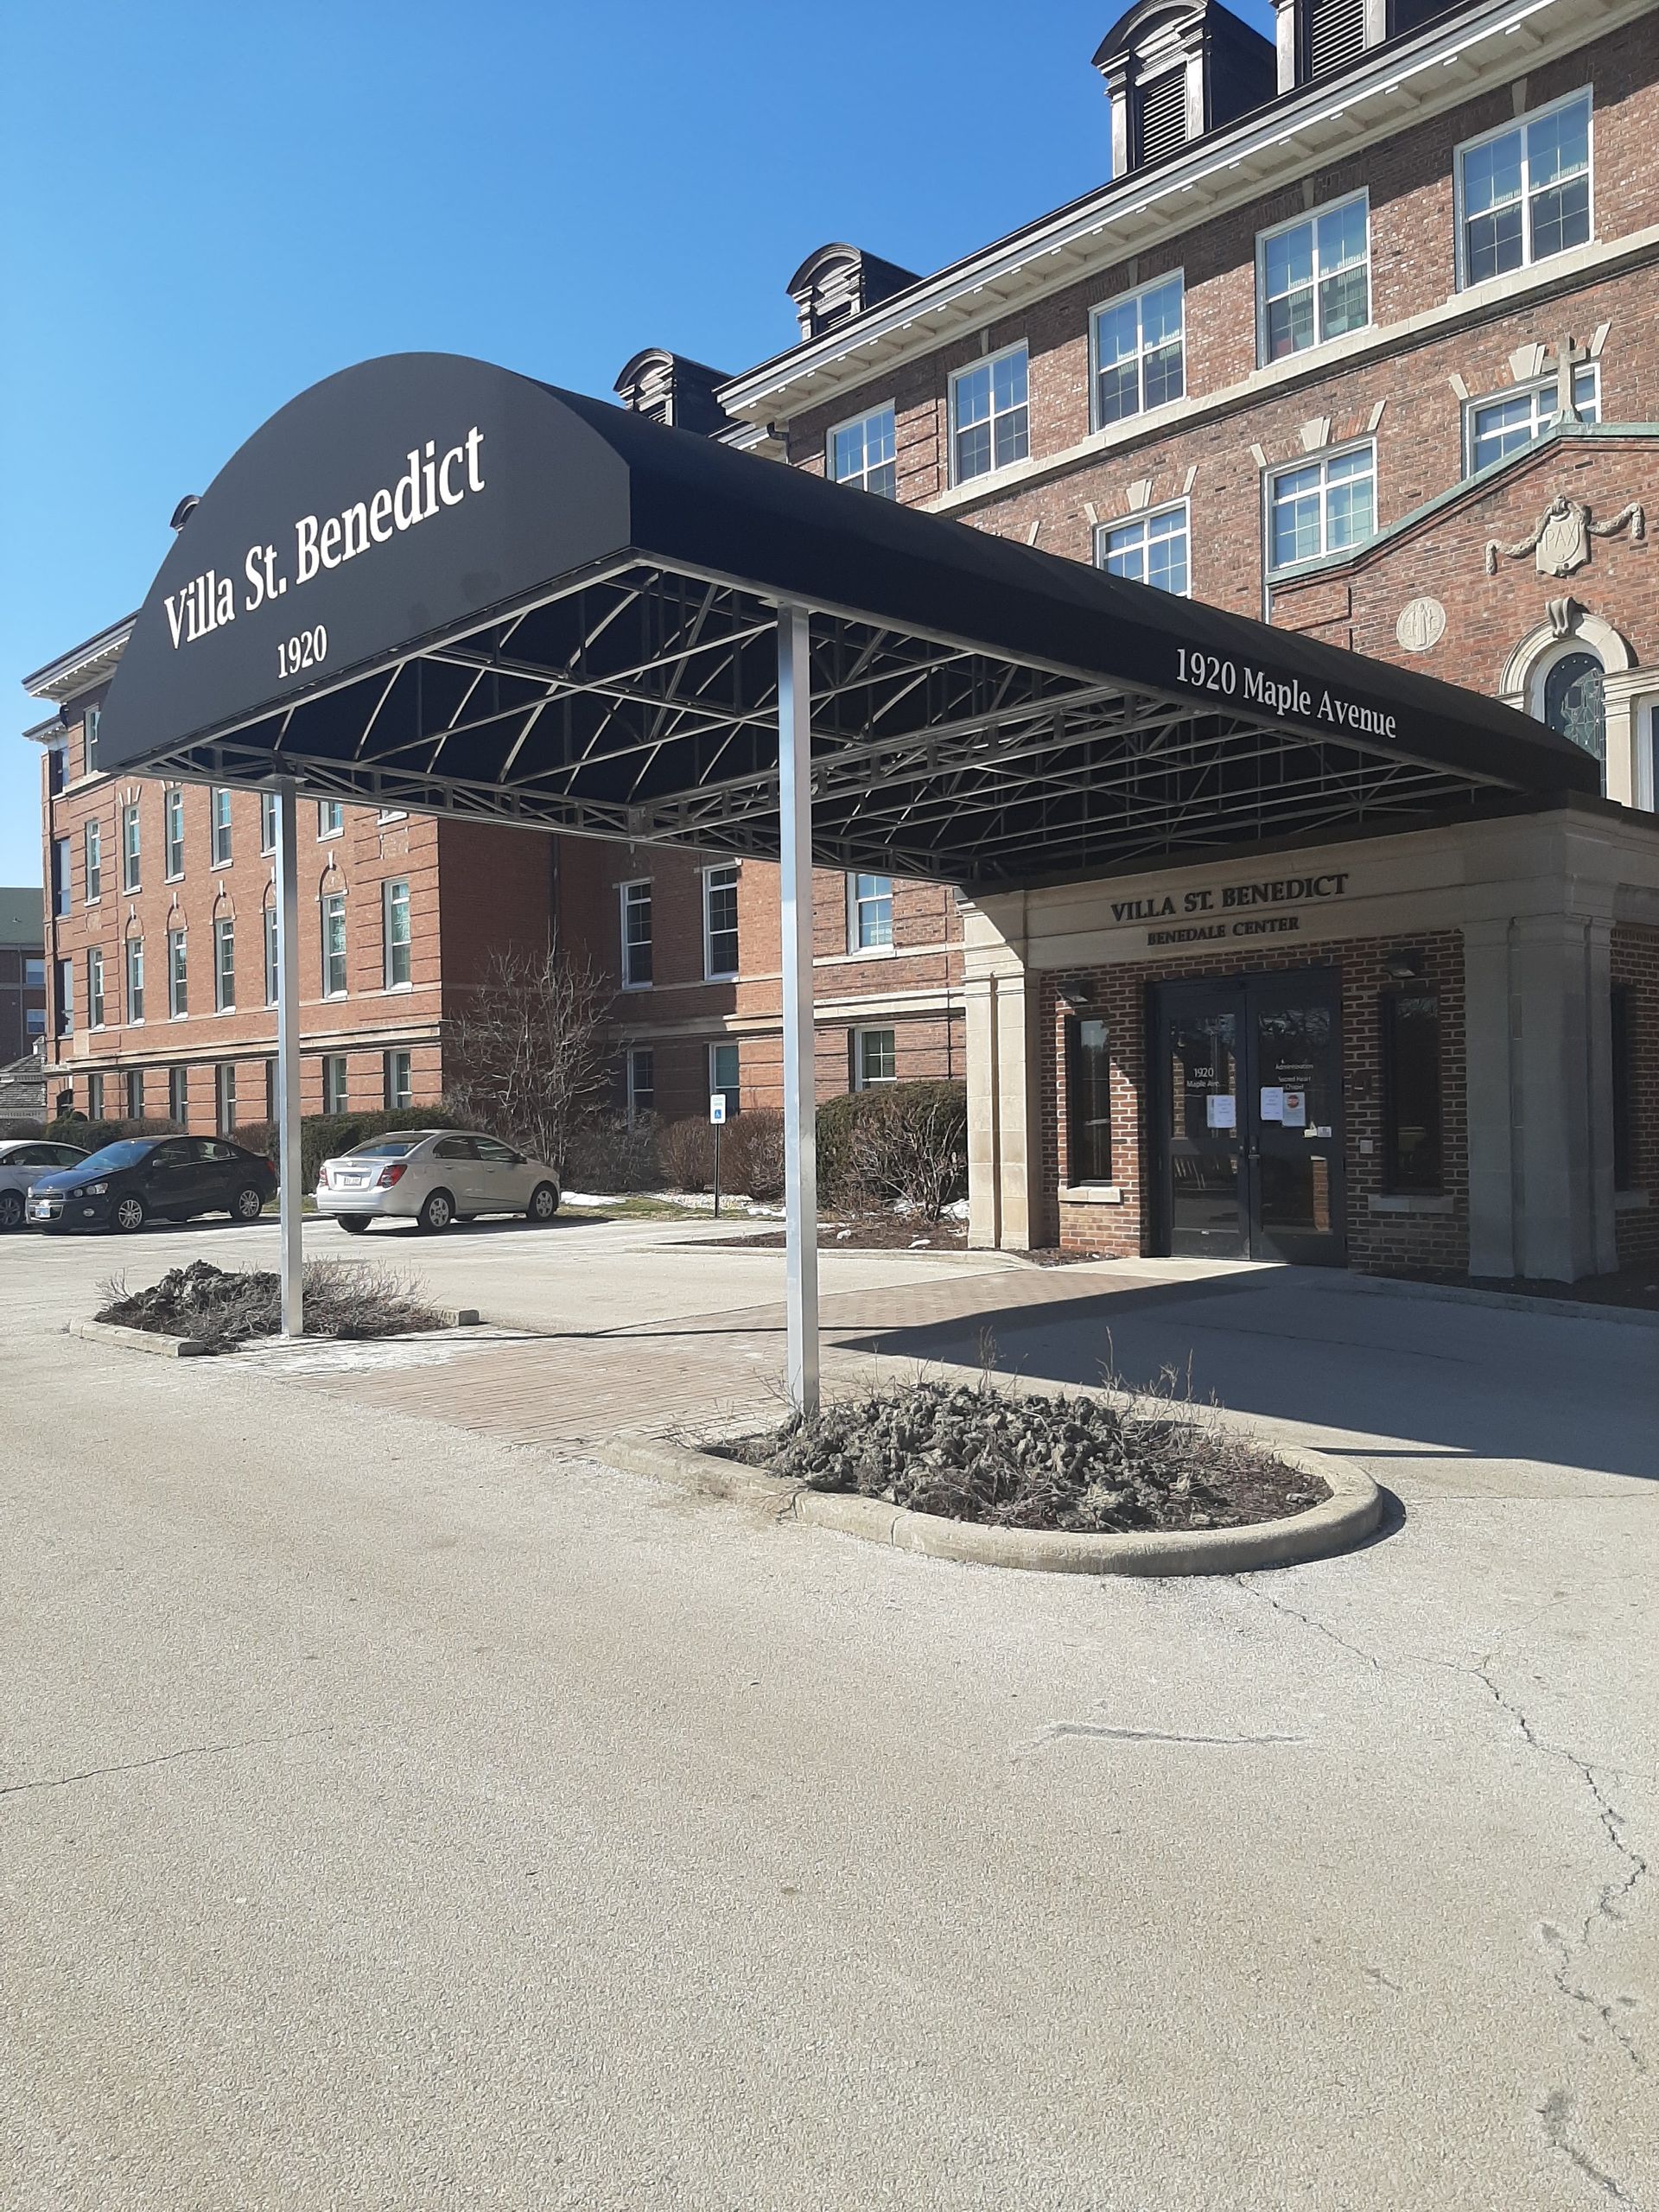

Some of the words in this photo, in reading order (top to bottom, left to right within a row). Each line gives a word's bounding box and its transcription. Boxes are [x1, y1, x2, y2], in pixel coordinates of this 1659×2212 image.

[163, 569, 235, 650] Villa
[245, 544, 288, 612] St.
[295, 426, 486, 585] Benedict
[1545, 523, 1576, 551] PAX
[276, 624, 328, 679] 1920
[1176, 648, 1236, 695] 1920
[1243, 667, 1312, 716] Maple
[1316, 690, 1397, 739] Avenue
[1110, 896, 1177, 922] VILLA
[1184, 890, 1214, 913] ST.
[1221, 873, 1350, 908] BENEDICT
[1147, 924, 1227, 947] BENEDALE
[1232, 917, 1300, 938] CENTER
[1193, 1067, 1215, 1078] 1920
